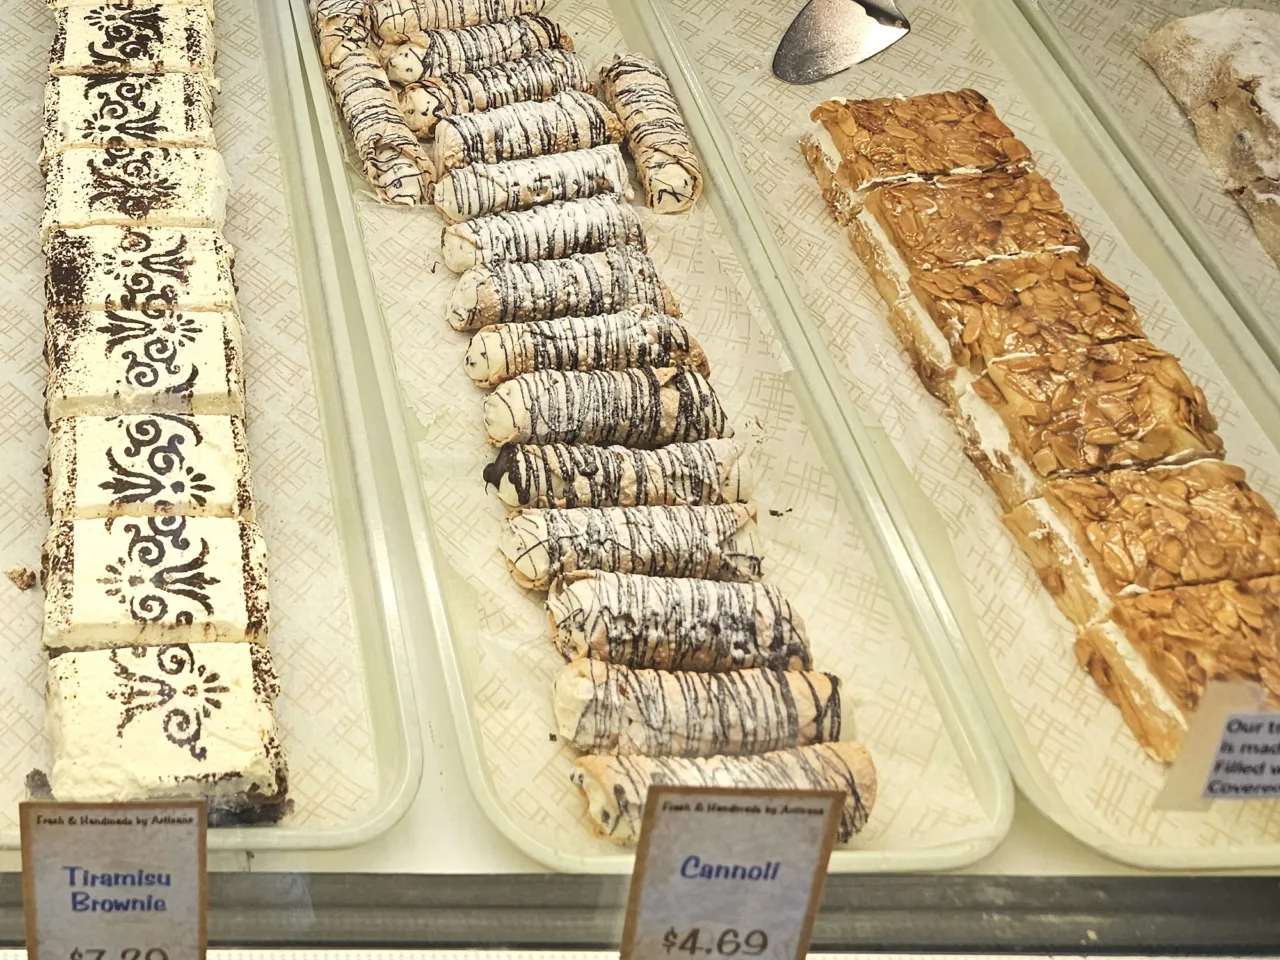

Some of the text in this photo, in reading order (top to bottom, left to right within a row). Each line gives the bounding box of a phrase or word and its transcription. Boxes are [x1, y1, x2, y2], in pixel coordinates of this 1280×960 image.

[1226, 718, 1264, 734] Our
[1214, 759, 1266, 776] Filled
[36, 814, 65, 825] Fresh
[68, 815, 77, 825] &
[80, 814, 133, 826] Handmade
[136, 815, 148, 827] by
[62, 866, 172, 887] Tiramisu
[680, 855, 781, 881] Cannoli
[71, 891, 167, 913] Brownie
[662, 926, 769, 956] $4.69
